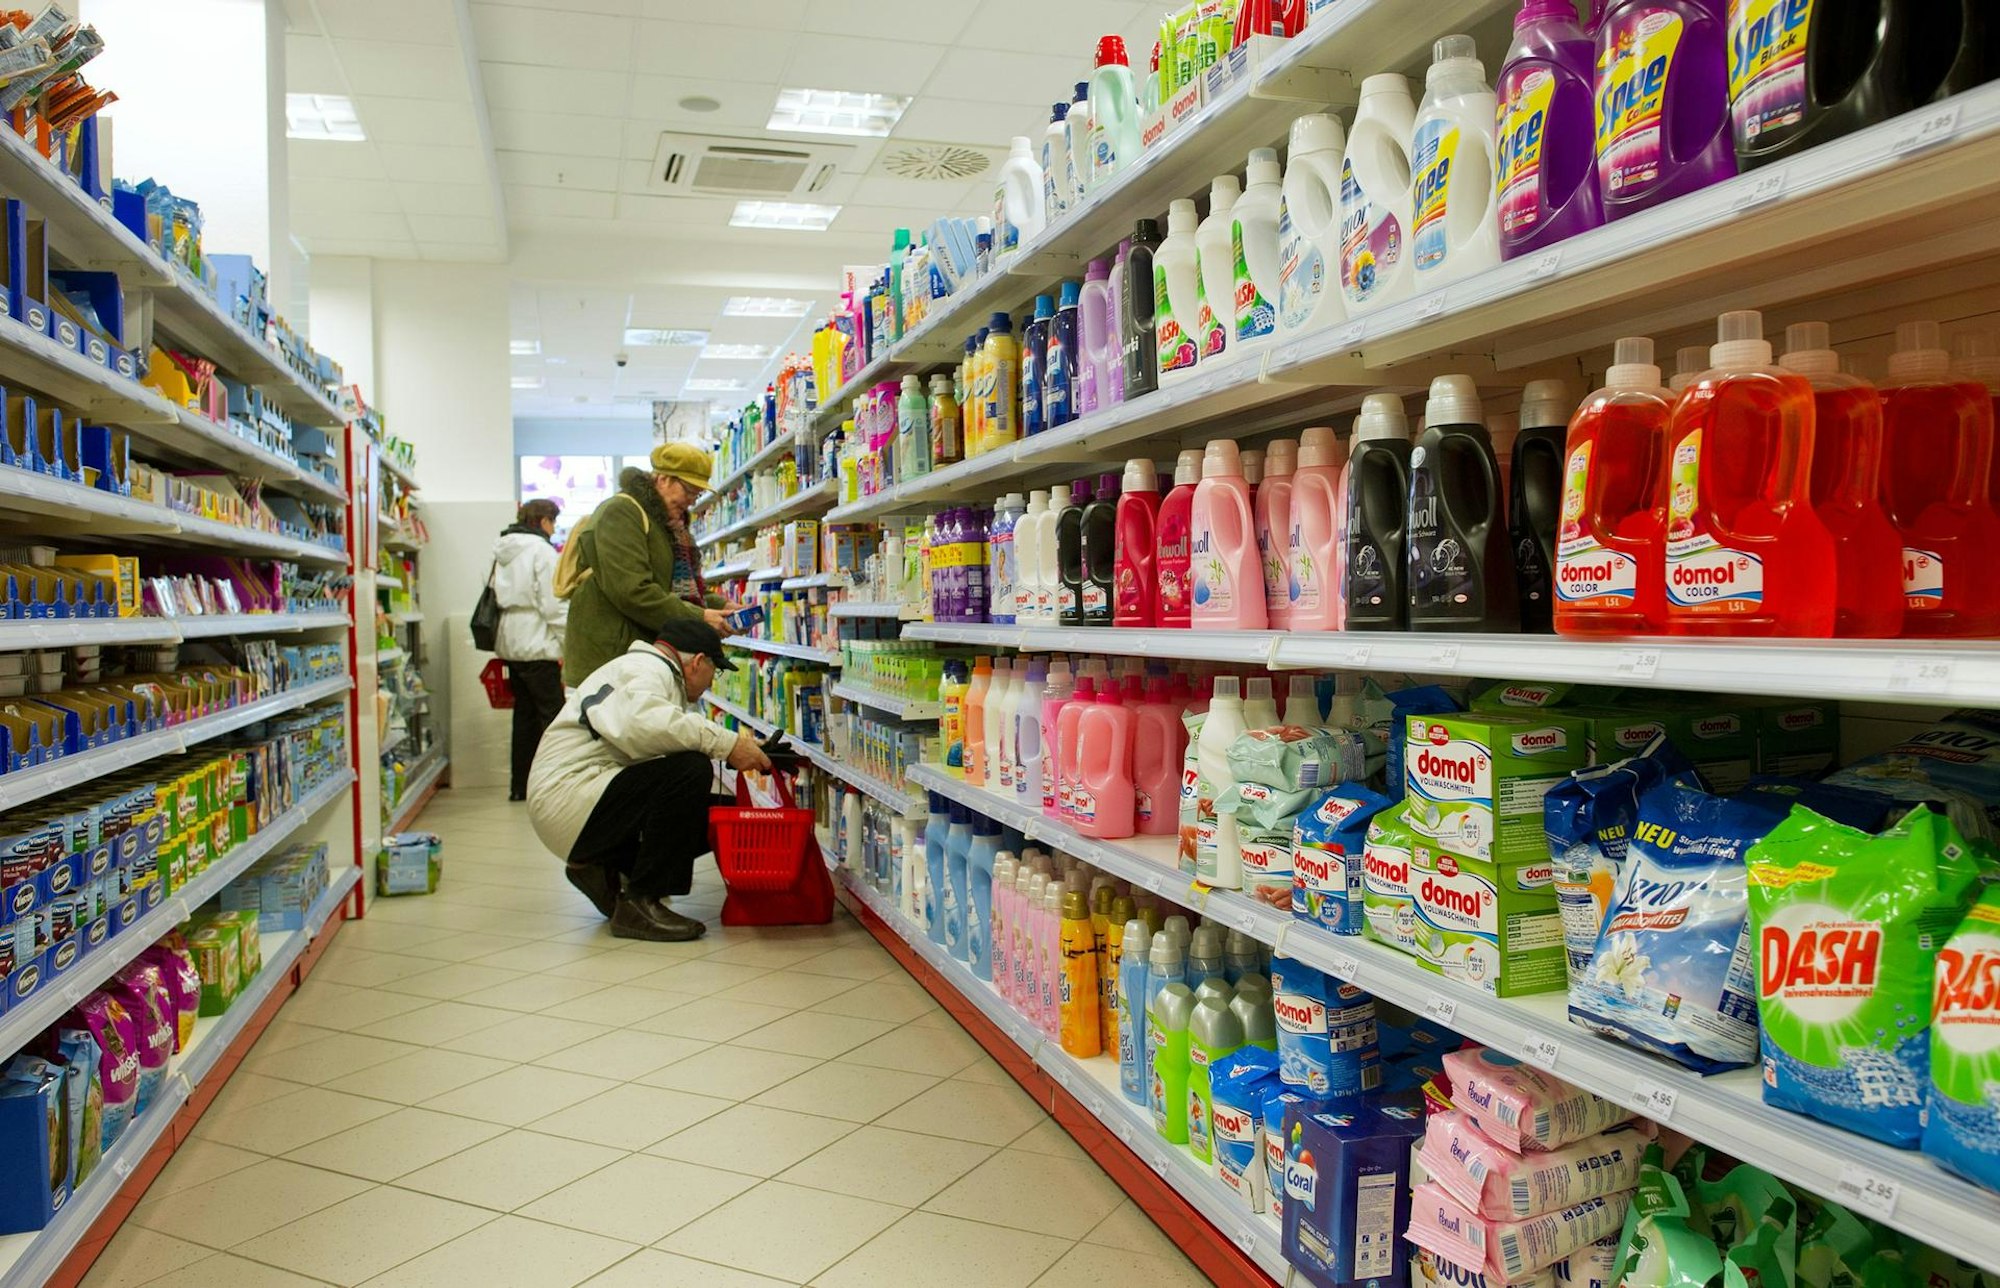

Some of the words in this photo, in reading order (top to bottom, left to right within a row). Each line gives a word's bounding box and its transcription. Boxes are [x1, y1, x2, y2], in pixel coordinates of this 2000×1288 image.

[1760, 33, 1797, 66] Black
[1172, 85, 1197, 119] domol
[1599, 55, 1667, 140] Spee
[1626, 98, 1657, 123] Color
[1143, 115, 1166, 146] domol
[1921, 112, 1956, 134] 2.95
[1498, 109, 1543, 182] Spee
[1514, 149, 1536, 172] Color
[1341, 204, 1368, 246] enor
[846, 272, 855, 292] omol
[1234, 282, 1256, 307] ASH
[1694, 391, 1713, 399] NEU
[1410, 496, 1437, 529] woll
[1561, 560, 1612, 582] domol
[1673, 561, 1734, 585] domol
[1016, 594, 1028, 604] mol
[1083, 592, 1098, 604] mol
[1570, 584, 1598, 592] COLOR
[1686, 586, 1719, 597] COLOR
[1636, 655, 1656, 667] 2.59
[1919, 664, 1950, 678] 2.59
[1700, 719, 1731, 733] domol
[1785, 711, 1815, 725] domol
[1521, 733, 1556, 747] domol
[1623, 728, 1656, 743] domol
[1418, 749, 1475, 784] domol
[1419, 776, 1474, 795] VOLLWASCHMITTEL
[739, 811, 784, 819] ROSSMANN
[1599, 825, 1626, 841] NEU
[1634, 821, 1677, 849] NEU
[1241, 849, 1268, 866] omol
[1294, 850, 1329, 881] domol
[1365, 851, 1408, 884] domol
[1301, 872, 1320, 887] COLOR
[1526, 868, 1552, 879] dom
[1421, 877, 1481, 918] domol
[1423, 903, 1480, 929] VOLLWASCHMITTEL
[1762, 926, 1880, 998] DASH
[1340, 985, 1361, 994] dom
[1932, 948, 2000, 1024] DAS
[1275, 997, 1312, 1025] domol
[1438, 1003, 1453, 1016] 2.99
[1538, 1042, 1556, 1057] 4.95
[1467, 1080, 1492, 1109] Perwoll
[1651, 1090, 1672, 1107] 4.95
[1213, 1108, 1241, 1133] omol
[1450, 1137, 1470, 1164] Perwoll
[1287, 1166, 1313, 1194] Coral
[1865, 1179, 1893, 1200] 2.95
[1438, 1207, 1460, 1233] Perwoll
